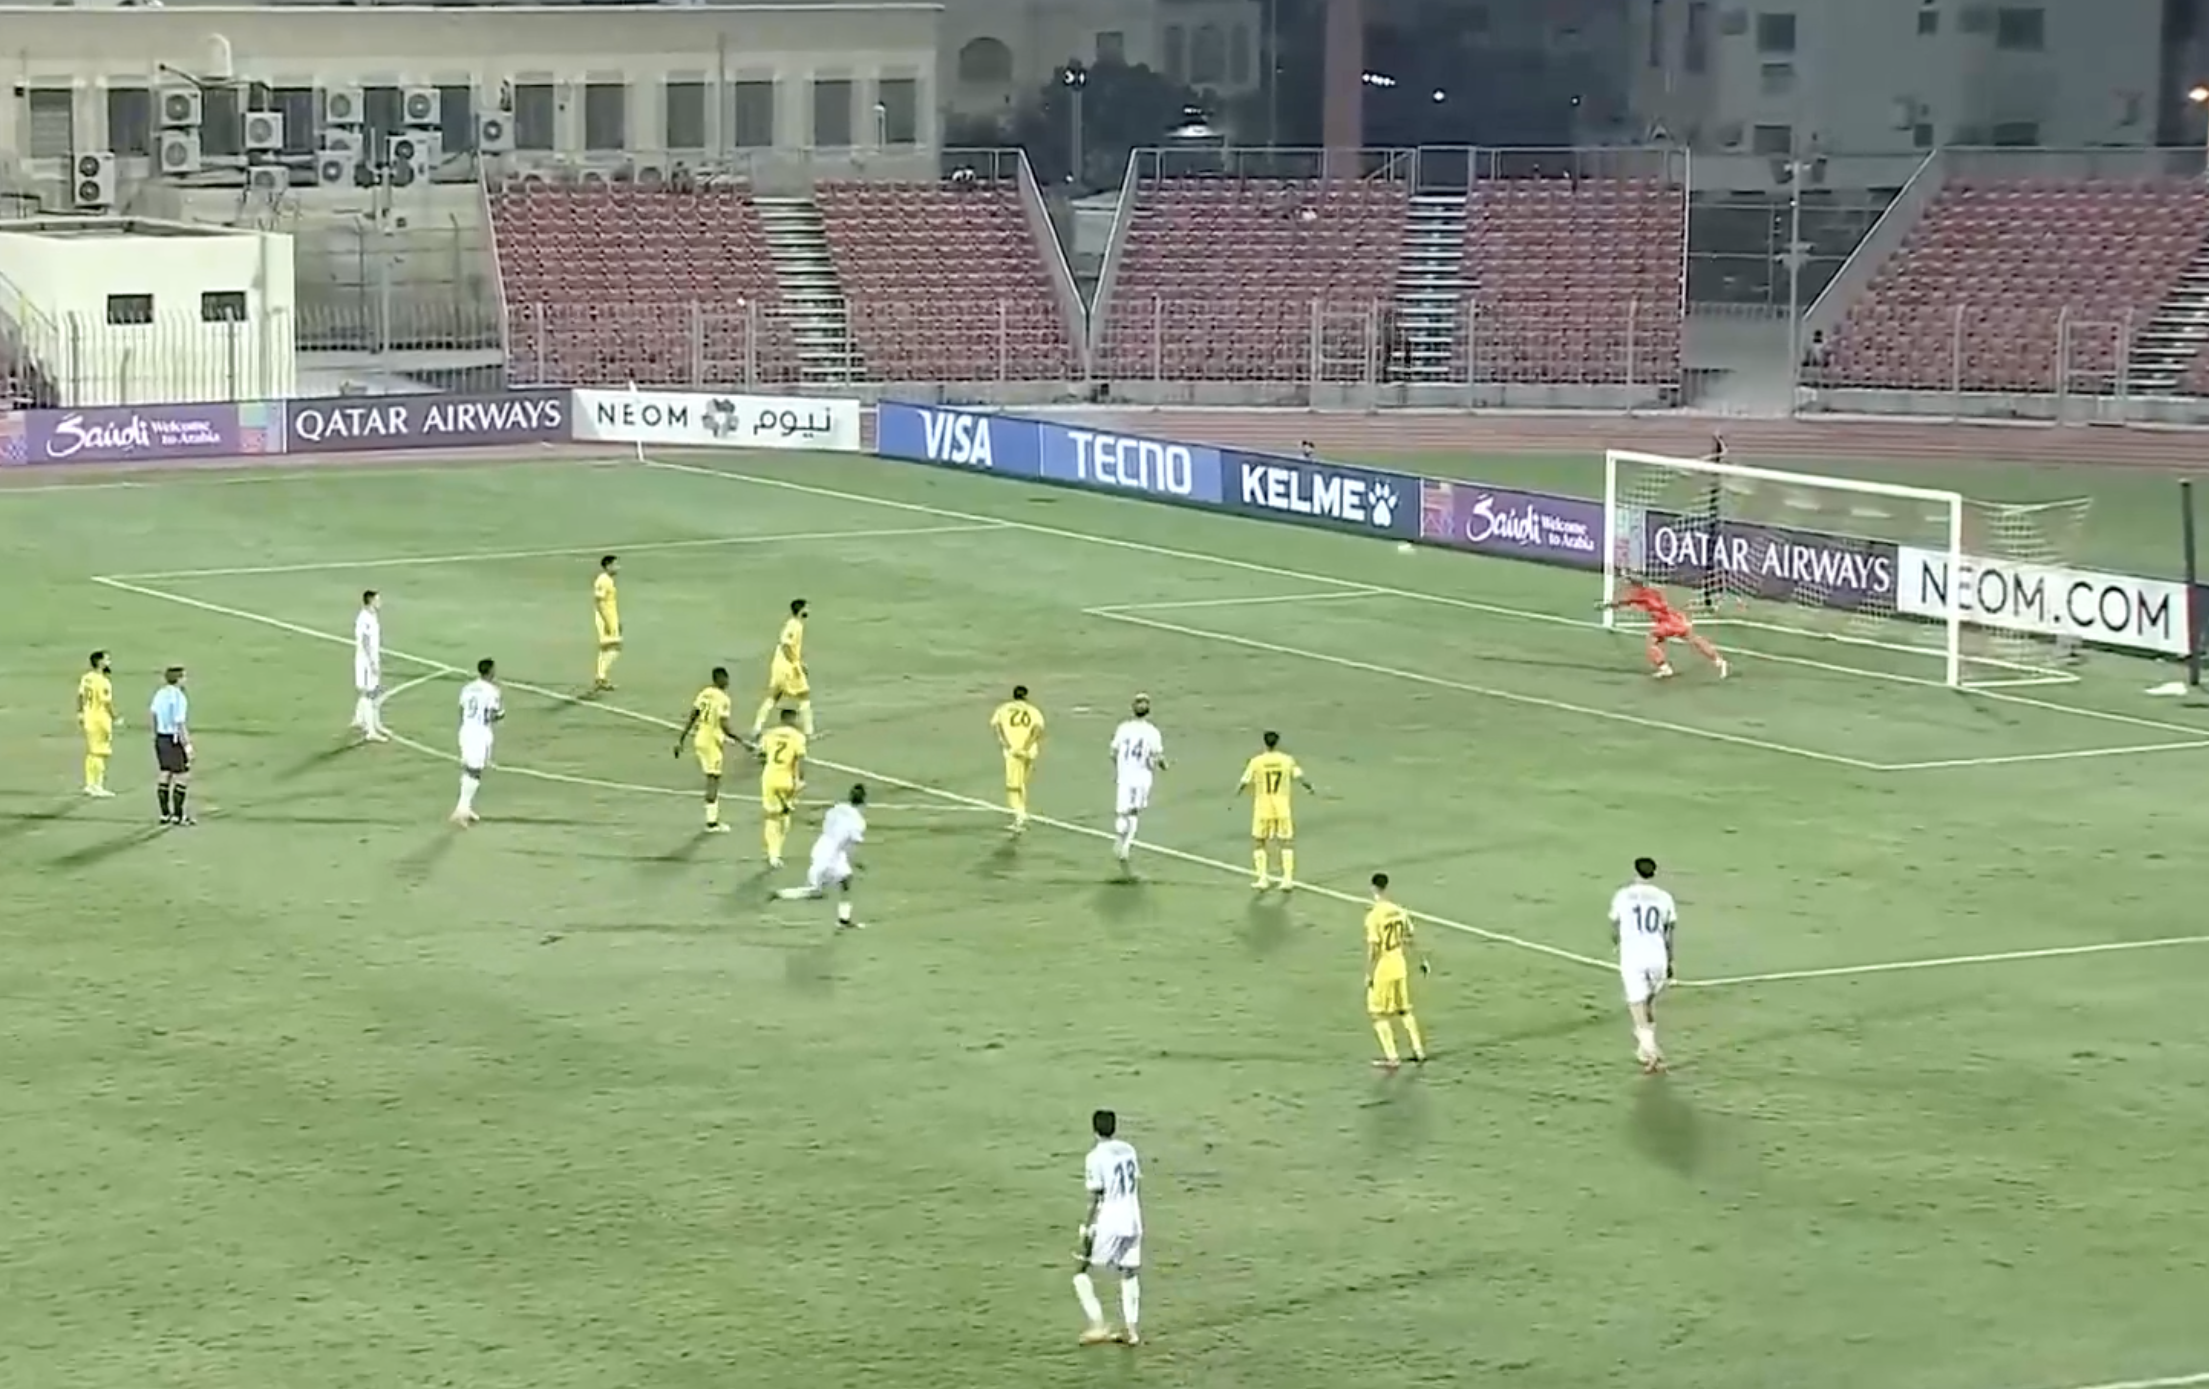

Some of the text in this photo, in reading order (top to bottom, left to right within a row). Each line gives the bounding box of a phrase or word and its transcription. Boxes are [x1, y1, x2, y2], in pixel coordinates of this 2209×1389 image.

[295, 400, 562, 442] QATAR AIRWAYS
[597, 402, 688, 428] NEOM
[753, 407, 832, 437] نيوم
[46, 412, 150, 458] Saudi
[916, 409, 993, 467] VISA
[1067, 431, 1192, 495] TECNO
[1241, 463, 1366, 521] KELME
[1466, 493, 1542, 546] Saudi
[1541, 513, 1589, 536] Welcome
[1549, 532, 1595, 551] to Arabia
[1654, 526, 1890, 592] QATAR AIRWAYS
[774, 741, 788, 764] 2
[1123, 738, 1144, 762] 14
[1266, 770, 1282, 795] 17
[1632, 904, 1660, 934] 10
[1384, 920, 1404, 951] 20
